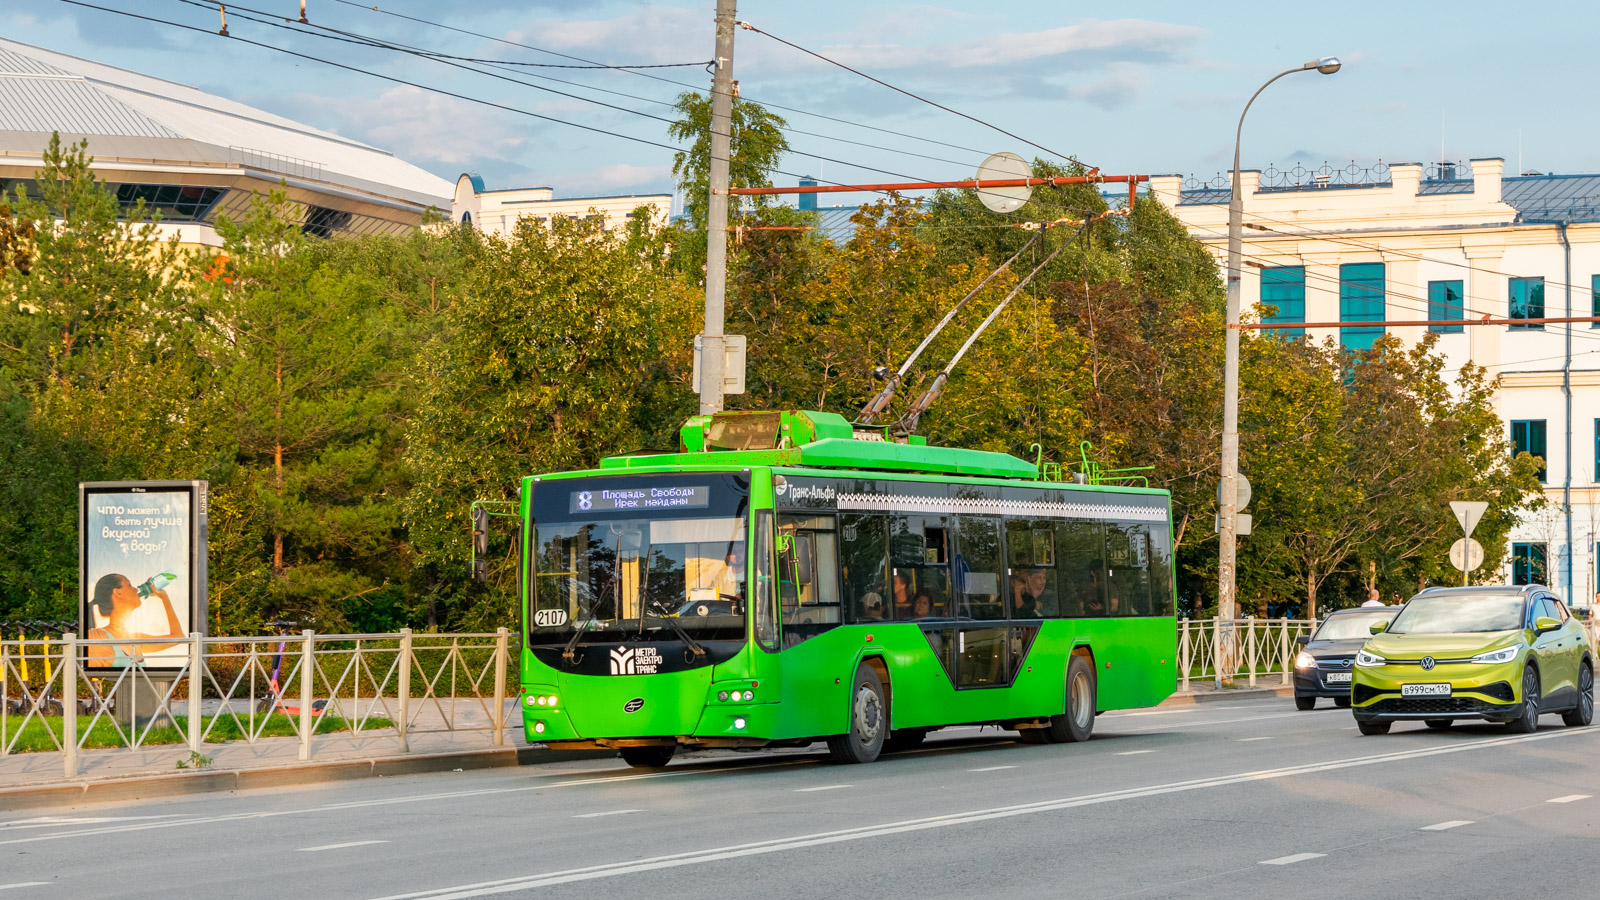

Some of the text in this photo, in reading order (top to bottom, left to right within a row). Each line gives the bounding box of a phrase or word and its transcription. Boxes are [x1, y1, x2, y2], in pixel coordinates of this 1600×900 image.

[602, 488, 695, 500] Площадь Свободы
[788, 484, 835, 503] Транс-Альфа
[578, 491, 593, 510] 8
[614, 499, 639, 508] Ирек
[97, 505, 124, 515] что
[114, 516, 183, 529] быть лучше
[102, 526, 150, 541] вкусной
[130, 539, 167, 554] воды?
[538, 611, 564, 625] 2107
[635, 647, 656, 656] МЕТРО
[635, 655, 663, 665] ЭЛЕКТРО
[635, 665, 658, 674] ТРАНС
